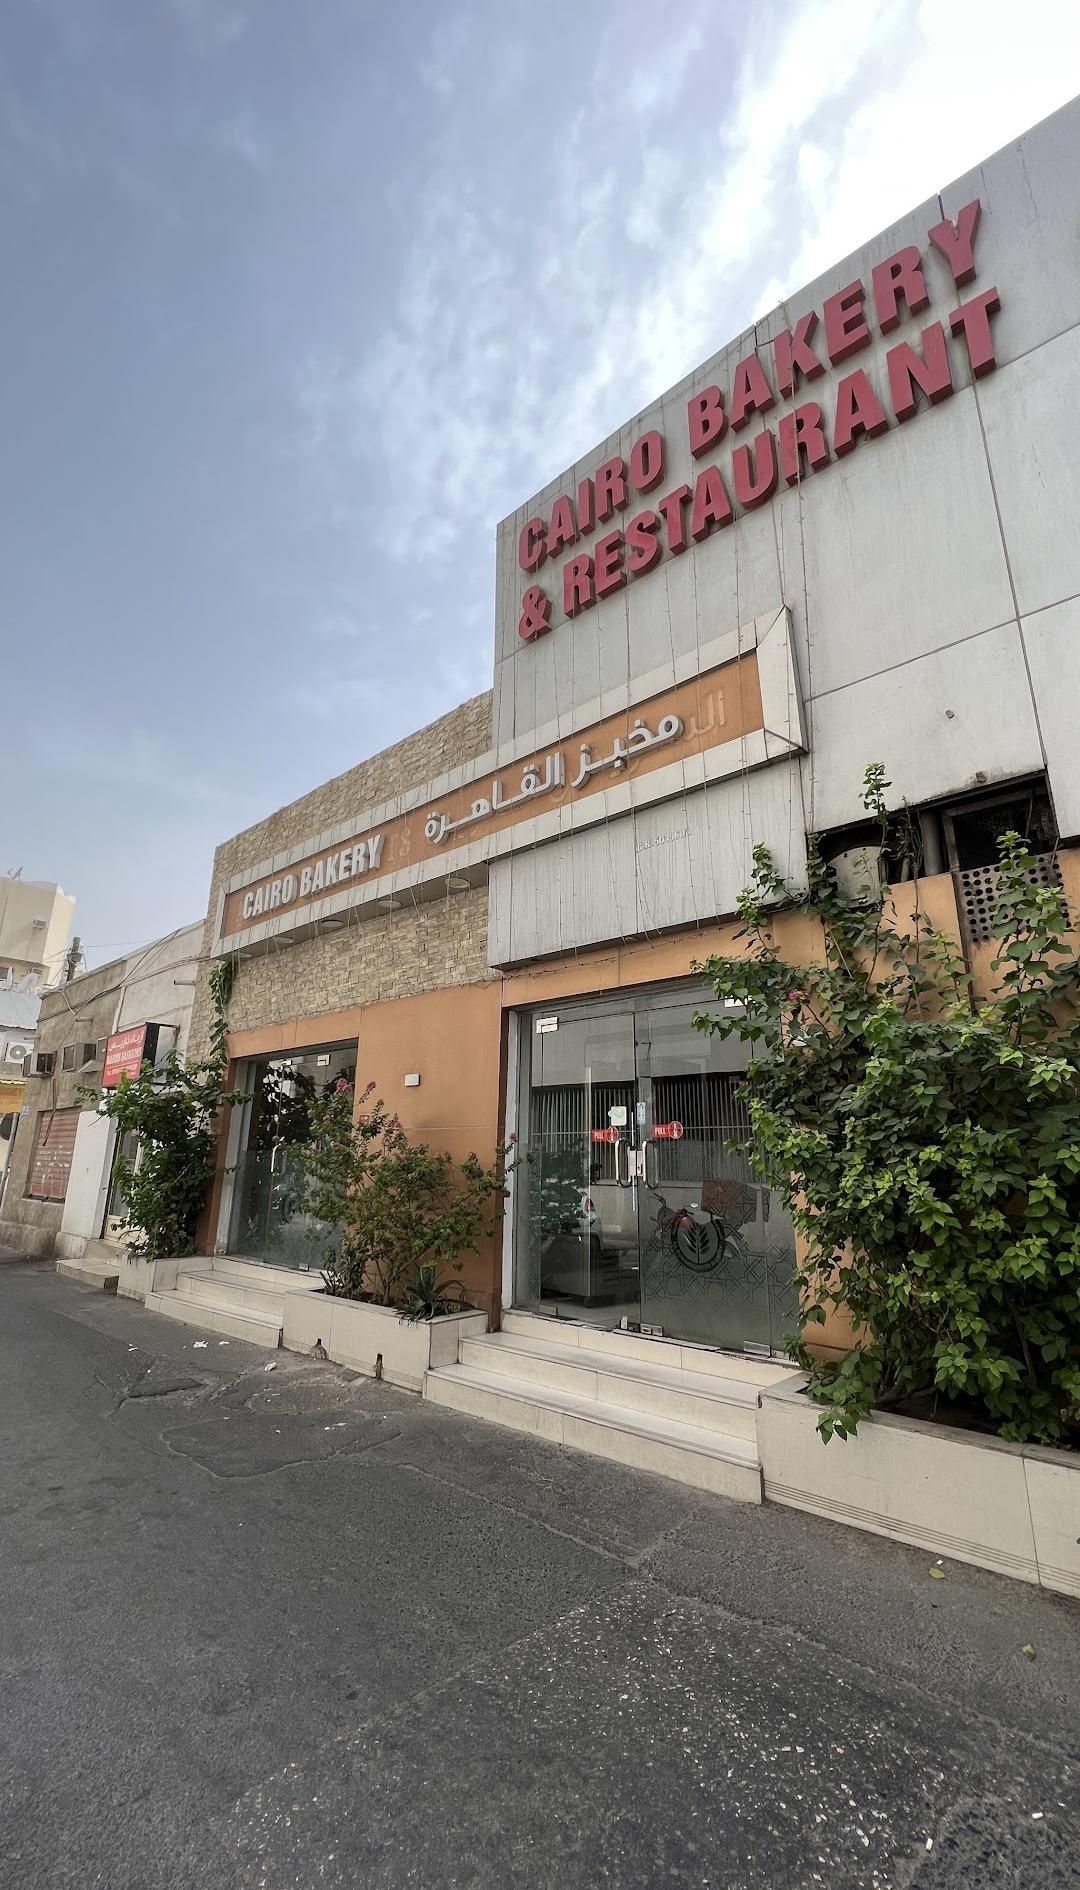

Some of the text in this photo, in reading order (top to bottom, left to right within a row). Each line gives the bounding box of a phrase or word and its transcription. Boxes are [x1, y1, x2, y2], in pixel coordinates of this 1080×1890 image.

[518, 199, 982, 573] CAIRO BAKERY
[518, 286, 1000, 641] & RESTAURANT
[571, 714, 685, 790] مخبز
[424, 751, 566, 845] القاهرة
[242, 874, 299, 920] CAIRO
[300, 834, 386, 898] BAKERY
[594, 1131, 605, 1140] PULL
[654, 1127, 667, 1135] PULL
